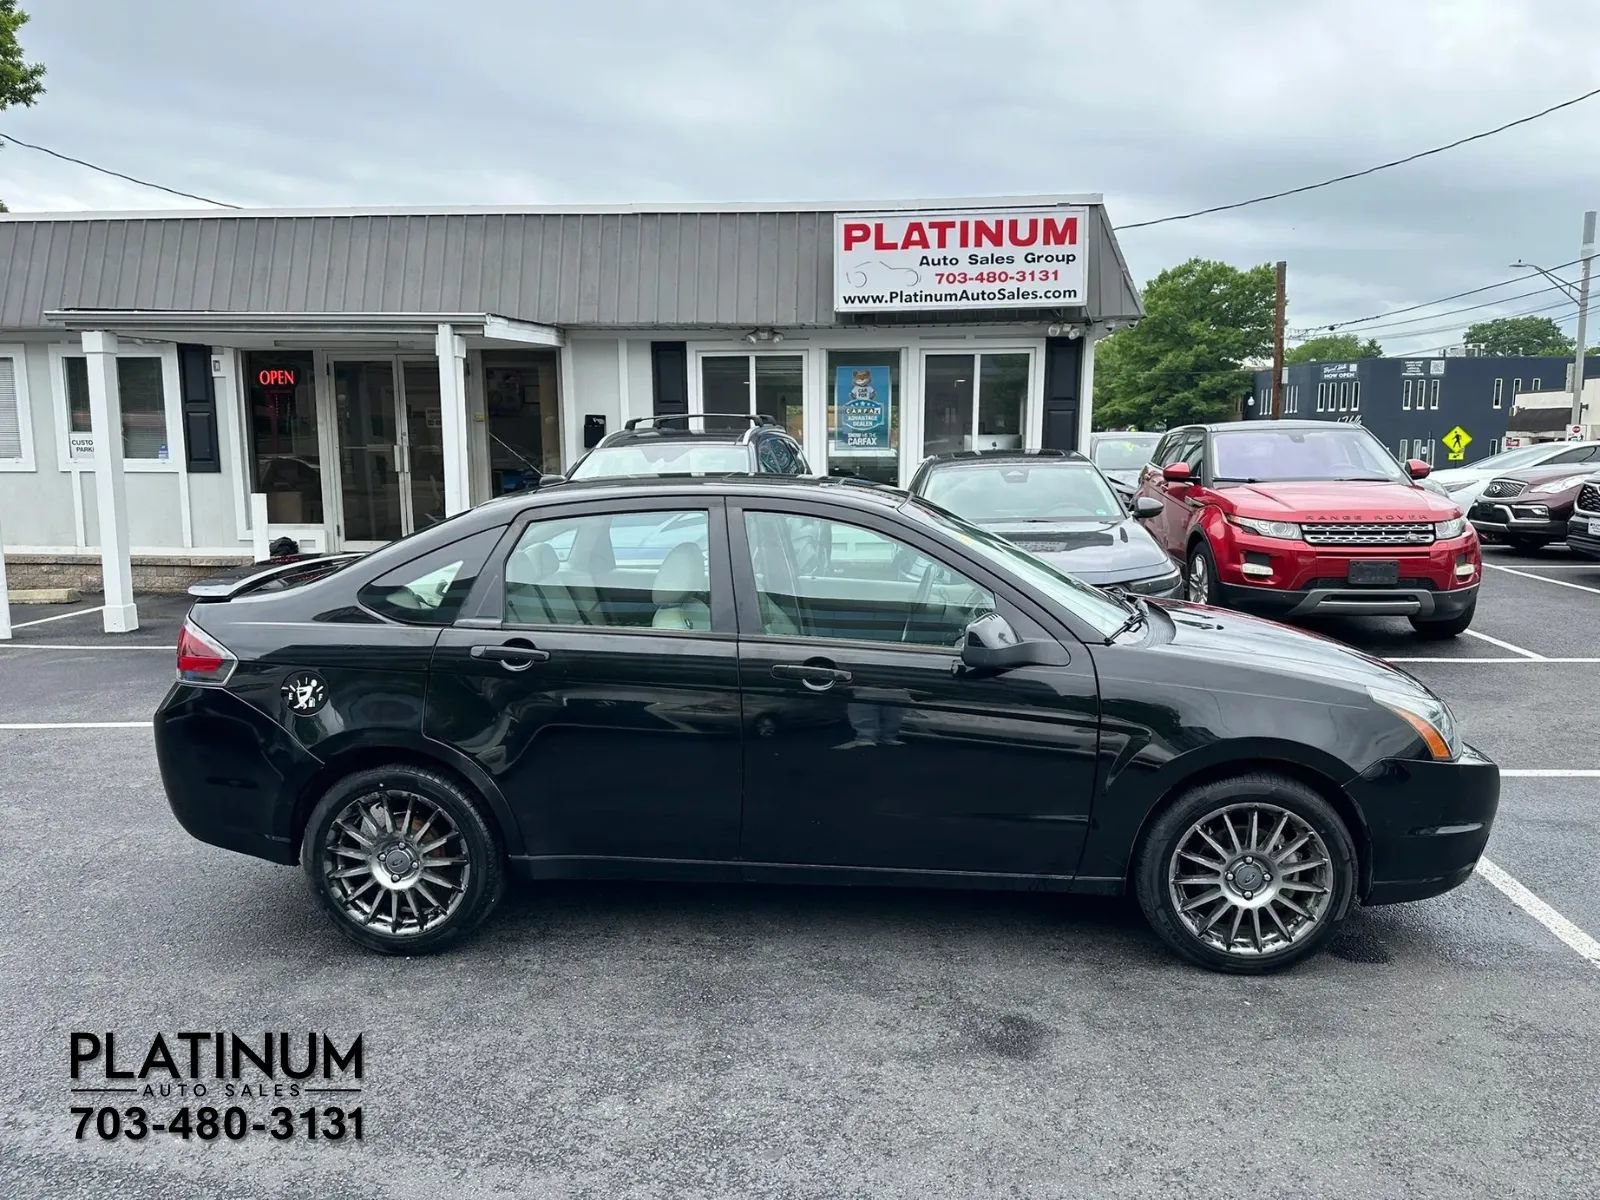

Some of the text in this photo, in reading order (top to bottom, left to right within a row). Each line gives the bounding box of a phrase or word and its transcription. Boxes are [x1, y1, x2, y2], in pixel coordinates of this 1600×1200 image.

[843, 217, 1078, 251] PLATINUM
[919, 252, 1077, 267] Auto Sales Group
[935, 269, 1060, 285] 703-480-3131
[843, 287, 1078, 305] www.PlatinumAutoSales.com
[259, 369, 295, 385] OPEN
[848, 438, 878, 446] CARFAX
